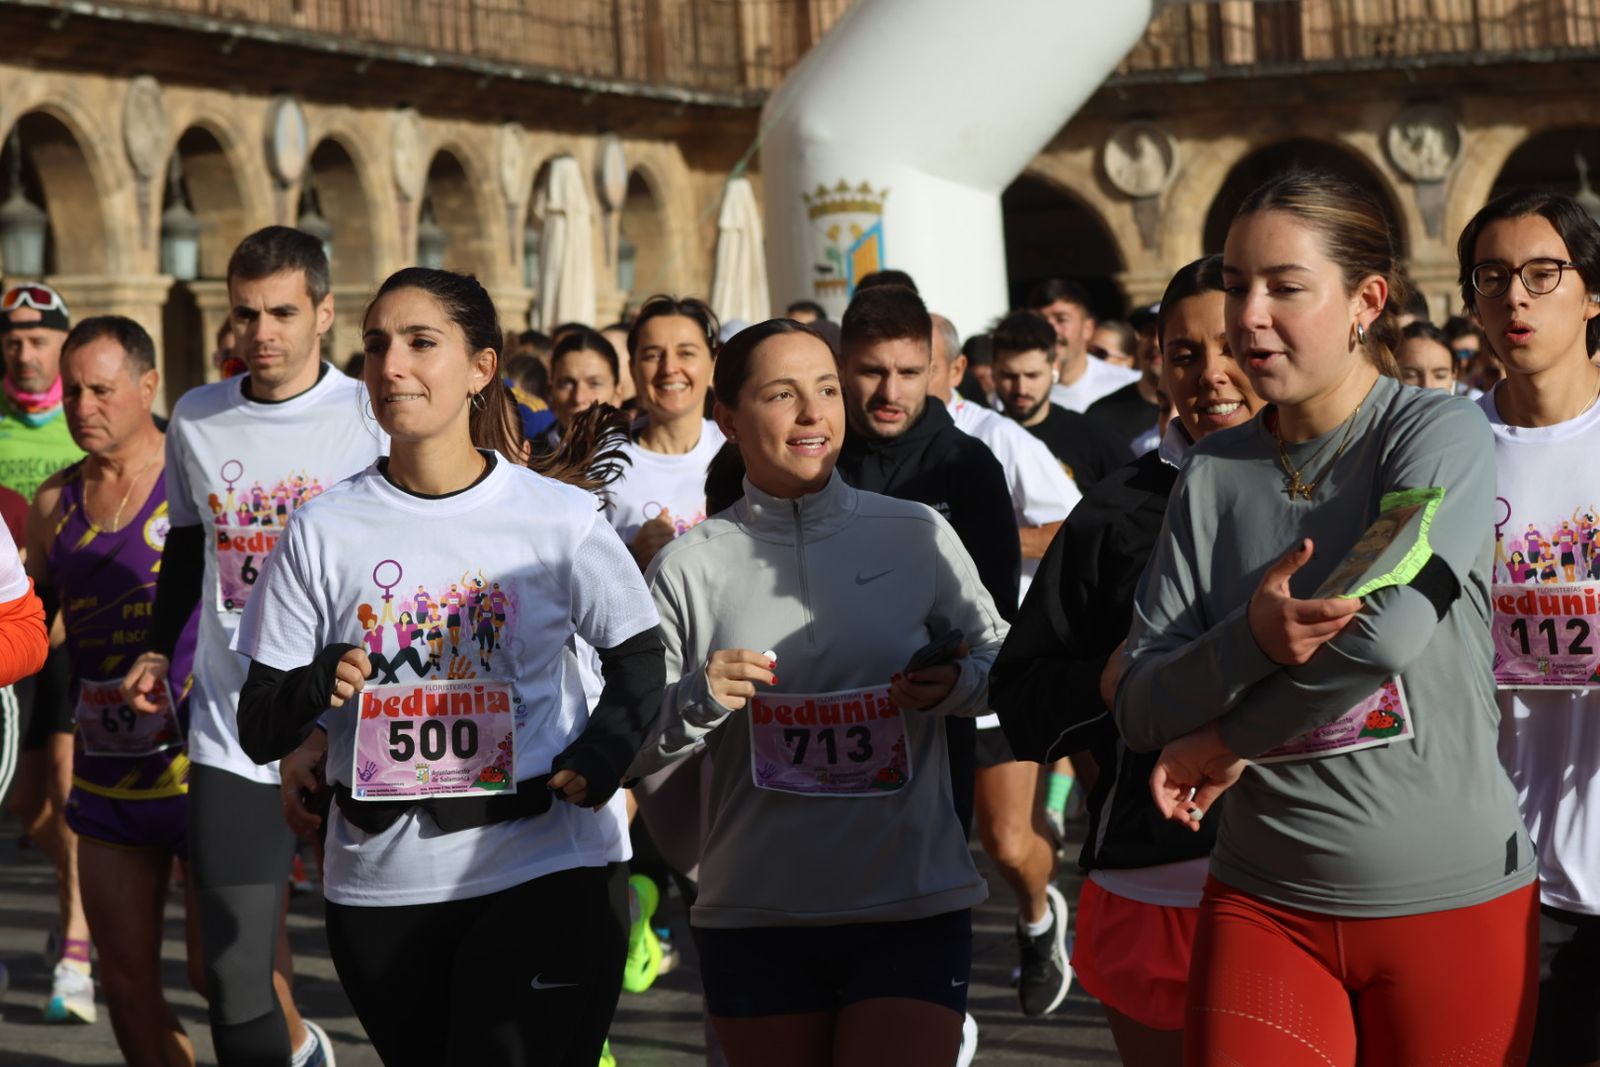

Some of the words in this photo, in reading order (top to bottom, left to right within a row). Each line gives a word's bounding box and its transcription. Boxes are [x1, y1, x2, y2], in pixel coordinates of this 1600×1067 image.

[1492, 587, 1600, 615] eduni
[1510, 618, 1594, 655] 112
[101, 705, 137, 733] 69
[361, 686, 510, 720] bedunia
[751, 690, 899, 726] bedunia
[389, 718, 479, 762] 500
[783, 726, 873, 765] 713
